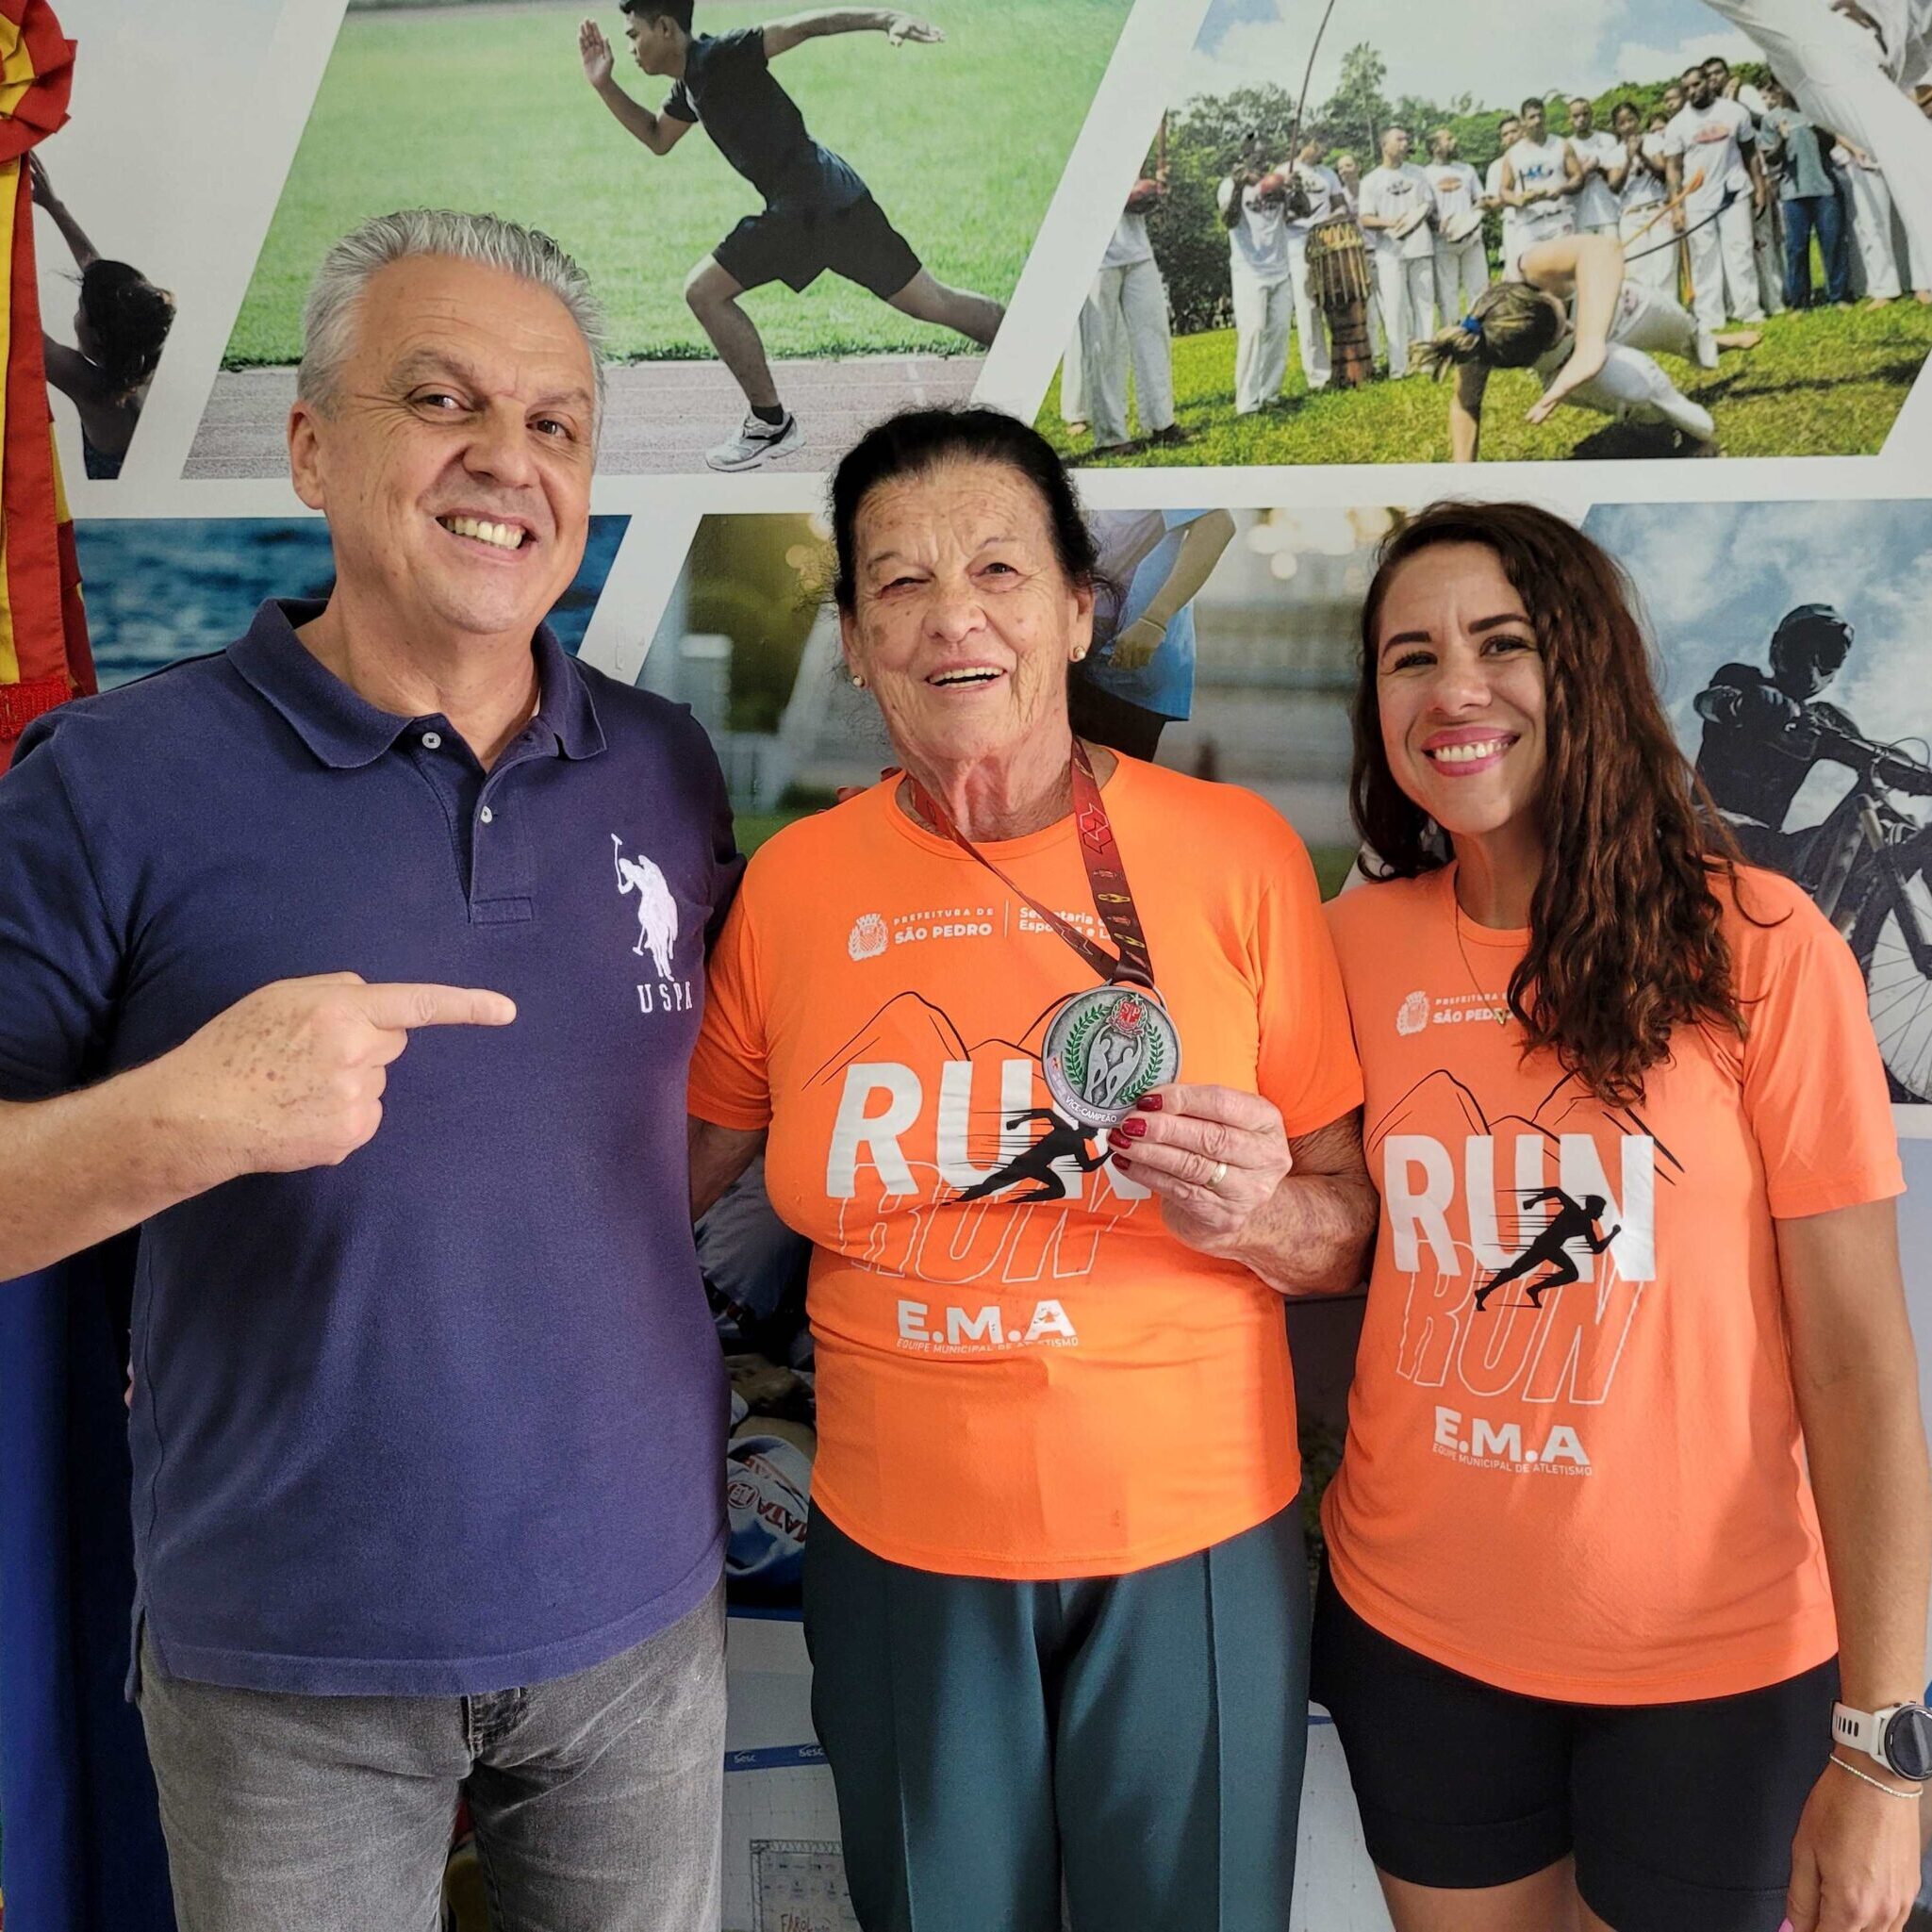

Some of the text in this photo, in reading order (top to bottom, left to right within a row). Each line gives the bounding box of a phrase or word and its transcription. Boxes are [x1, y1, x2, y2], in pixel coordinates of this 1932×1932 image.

[894, 908, 994, 926] PREFEITURA DE
[895, 923, 993, 945] SÃO PEDRO
[1433, 1008, 1514, 1024] SÃO PED
[1065, 1096, 1117, 1124] VICE-CAMPEÃO
[1384, 1134, 1656, 1283] RUN
[898, 1299, 1077, 1345] E.M.A
[897, 1338, 930, 1352] EQUIPE
[933, 1344, 993, 1355] MUNICIPAL
[1435, 1406, 1590, 1465] E.M.A
[1432, 1443, 1593, 1477] EQUIPE MUNICIPAL DE ATLETISMO
